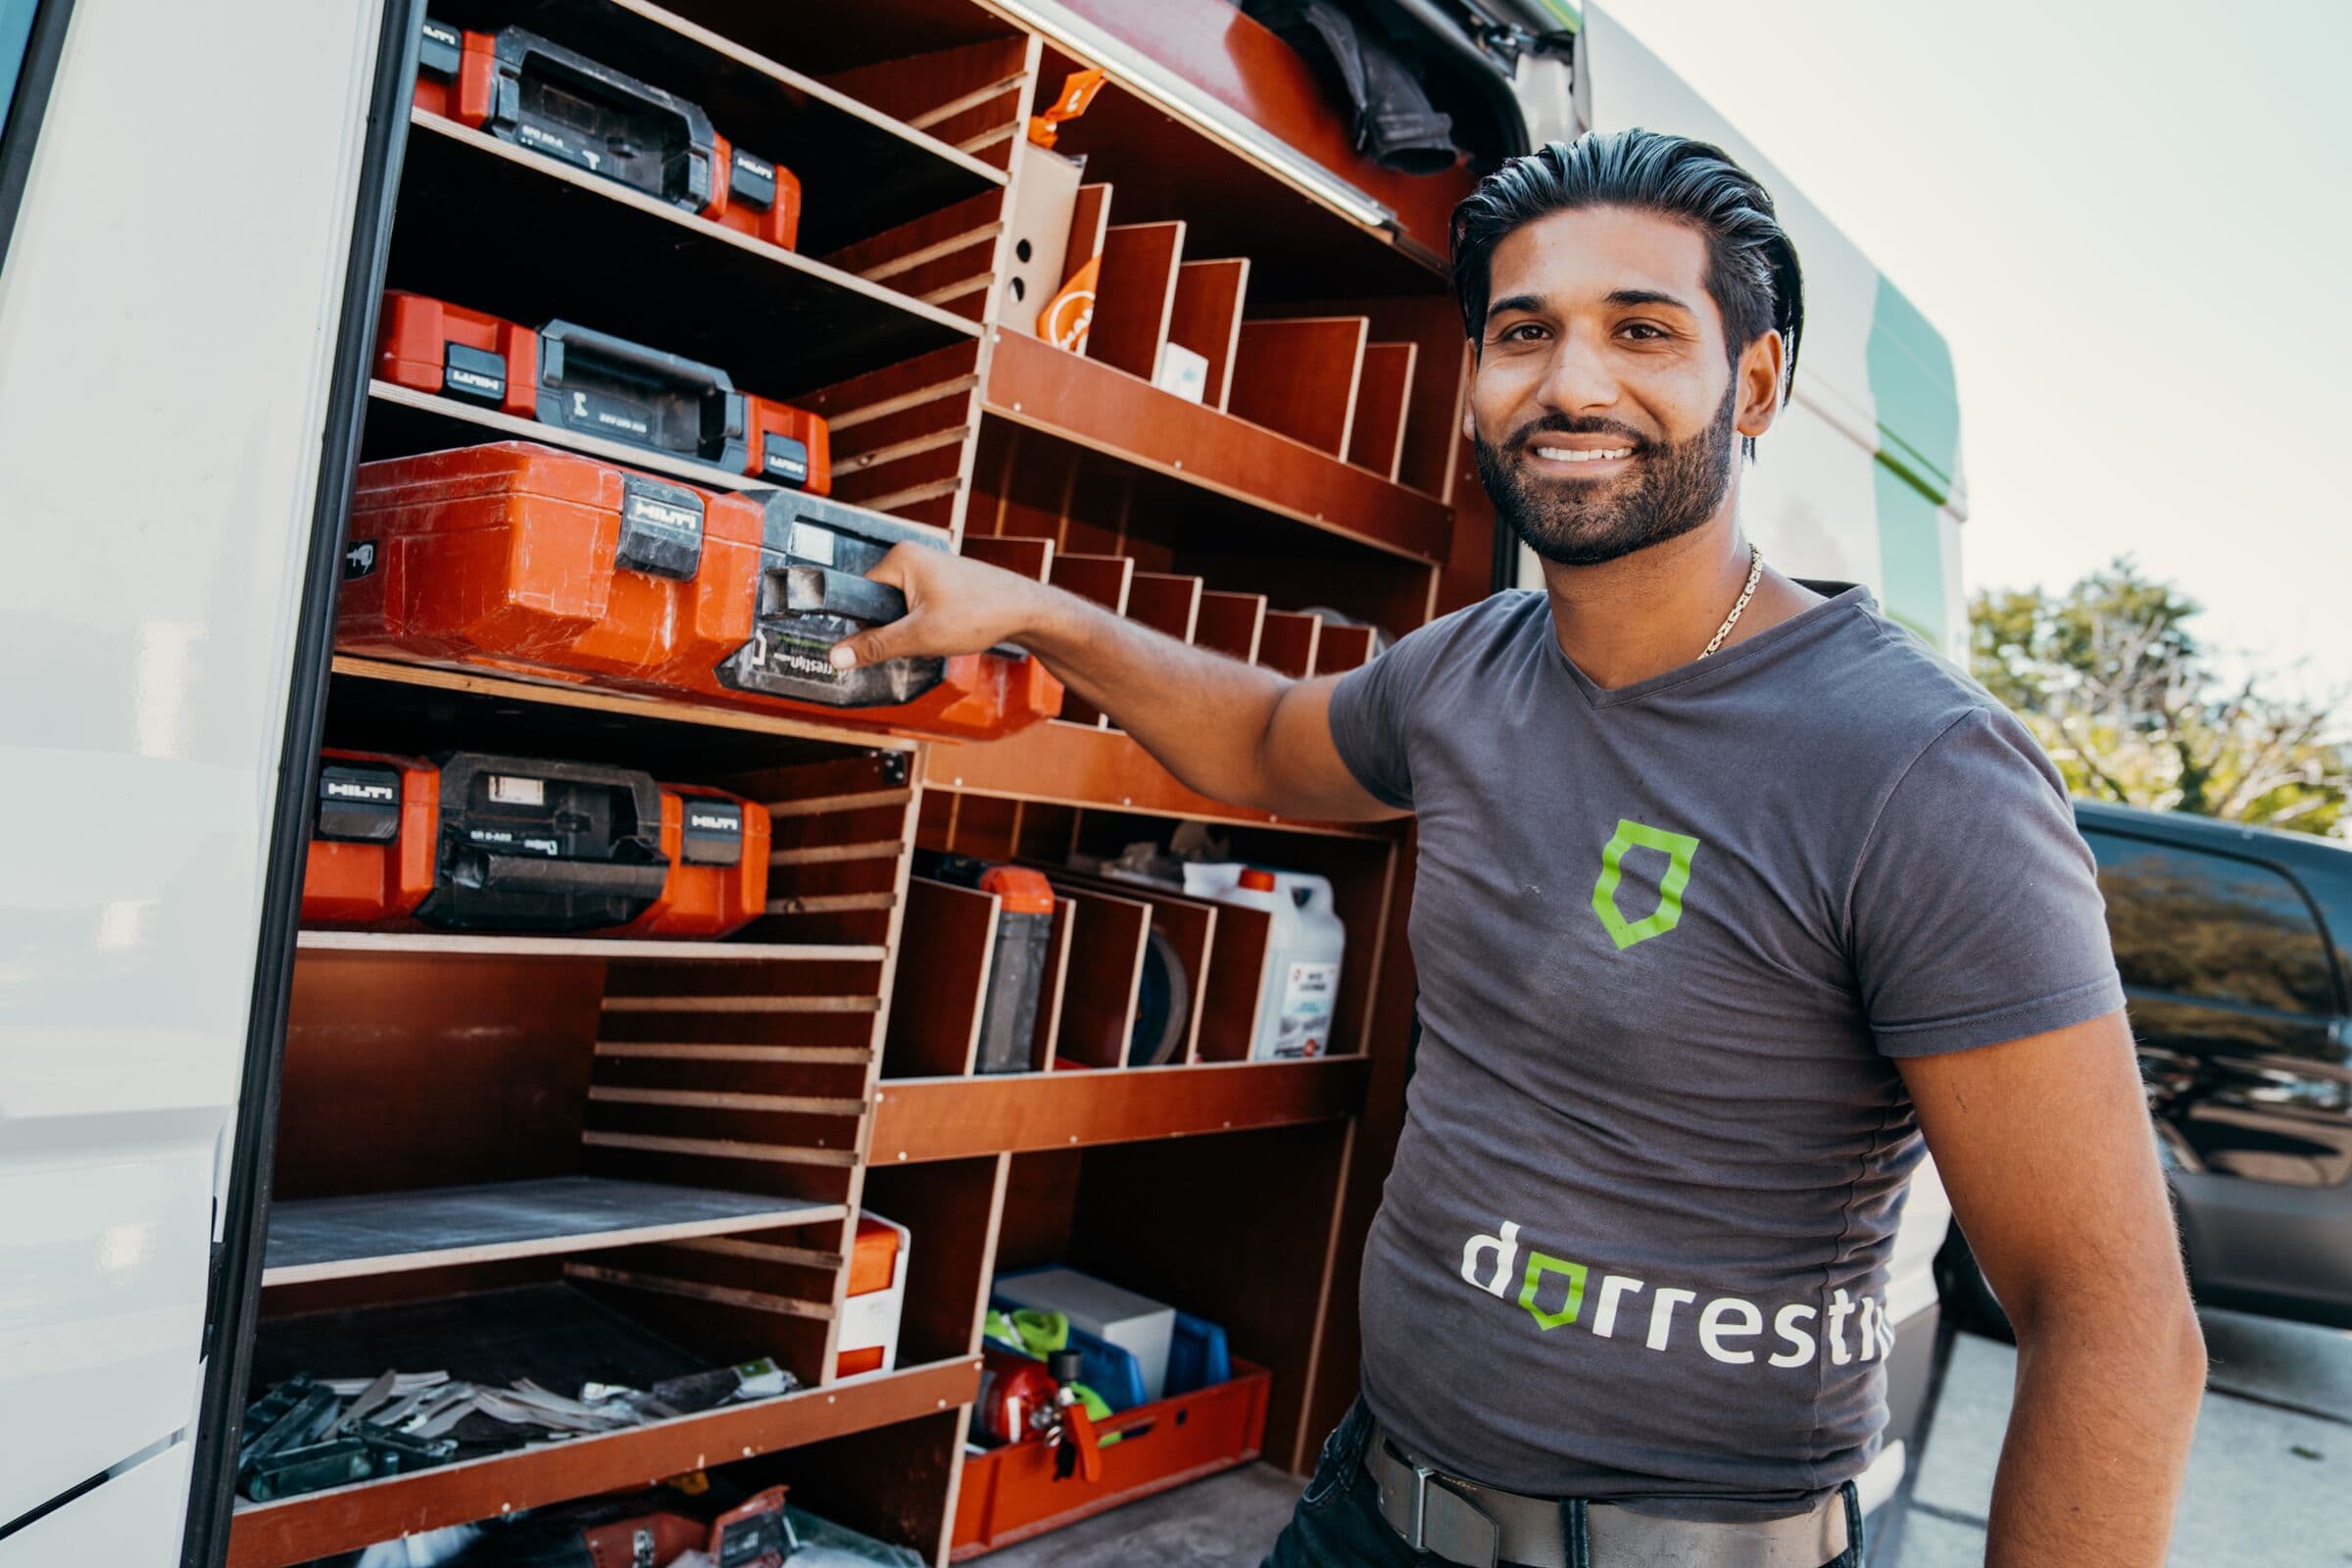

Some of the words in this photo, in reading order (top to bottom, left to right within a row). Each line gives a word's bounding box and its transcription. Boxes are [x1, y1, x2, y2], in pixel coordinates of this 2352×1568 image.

[422, 24, 456, 45] ILTI
[737, 157, 772, 179] HILTI
[453, 370, 500, 391] HILTI
[635, 502, 697, 530] HILTI
[328, 783, 393, 800] HILTI
[692, 815, 738, 831] HILTI
